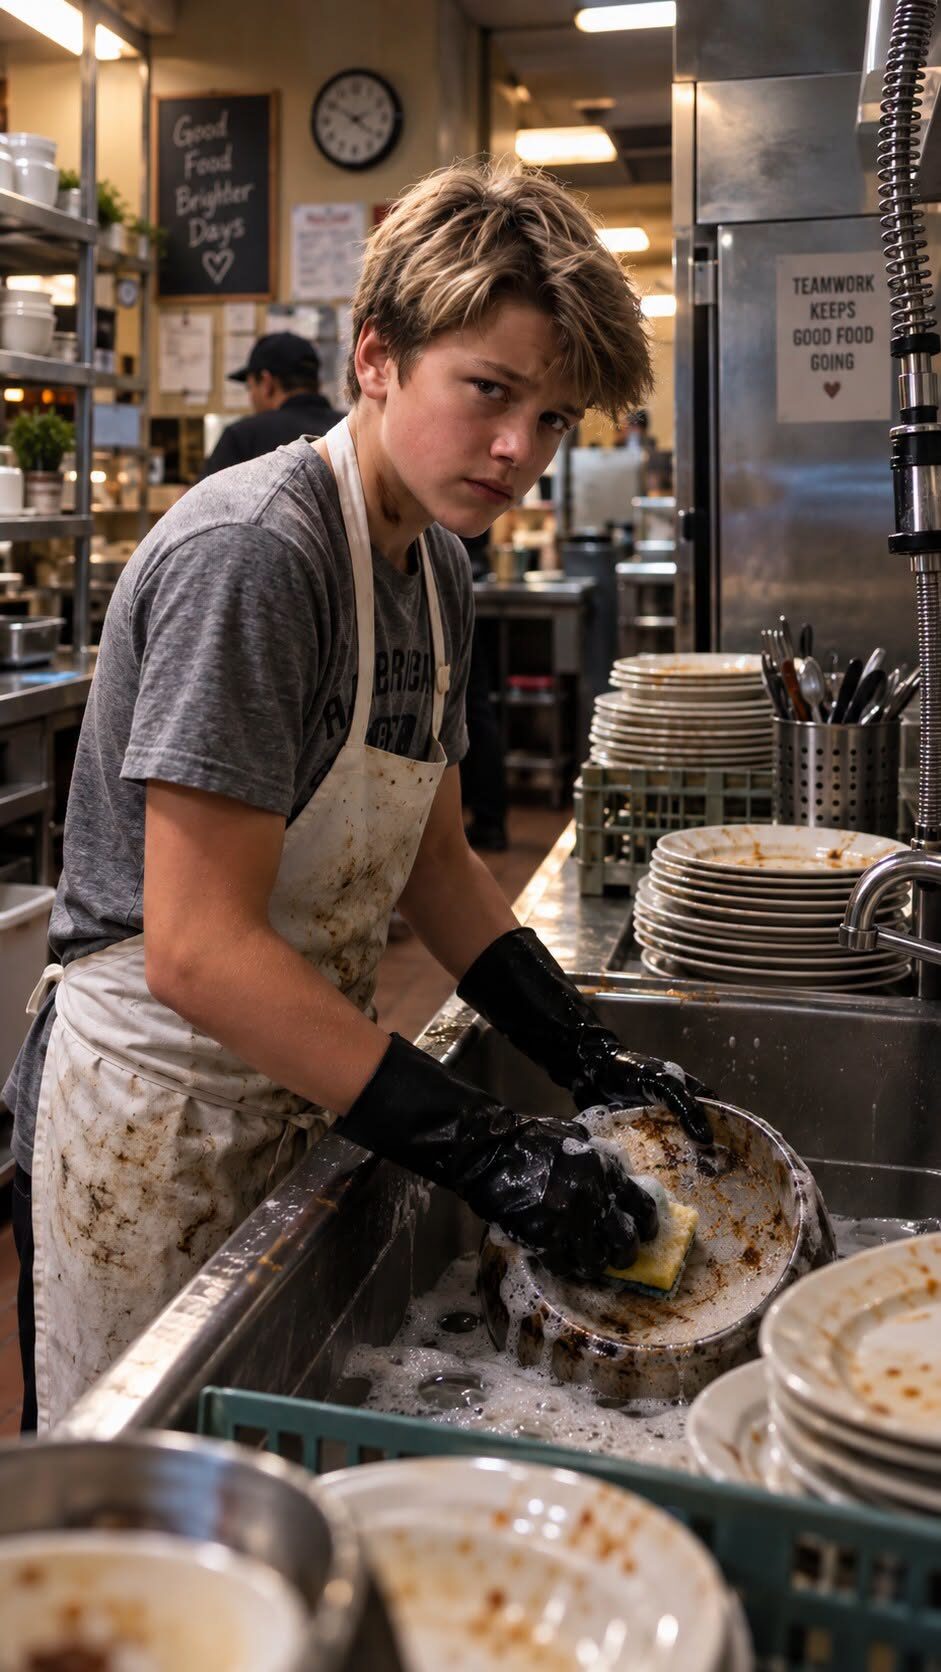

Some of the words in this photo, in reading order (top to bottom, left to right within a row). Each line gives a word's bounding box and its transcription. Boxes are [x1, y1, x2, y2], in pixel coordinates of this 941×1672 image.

[173, 111, 229, 147] Good
[184, 143, 233, 180] Food
[176, 181, 255, 219] Brighter
[188, 217, 245, 248] Days
[793, 275, 875, 295] TEAMWORK
[810, 302, 856, 320] KEEPS
[793, 328, 831, 346] GOOD
[837, 326, 874, 345] FOOD
[811, 353, 854, 371] GOING
